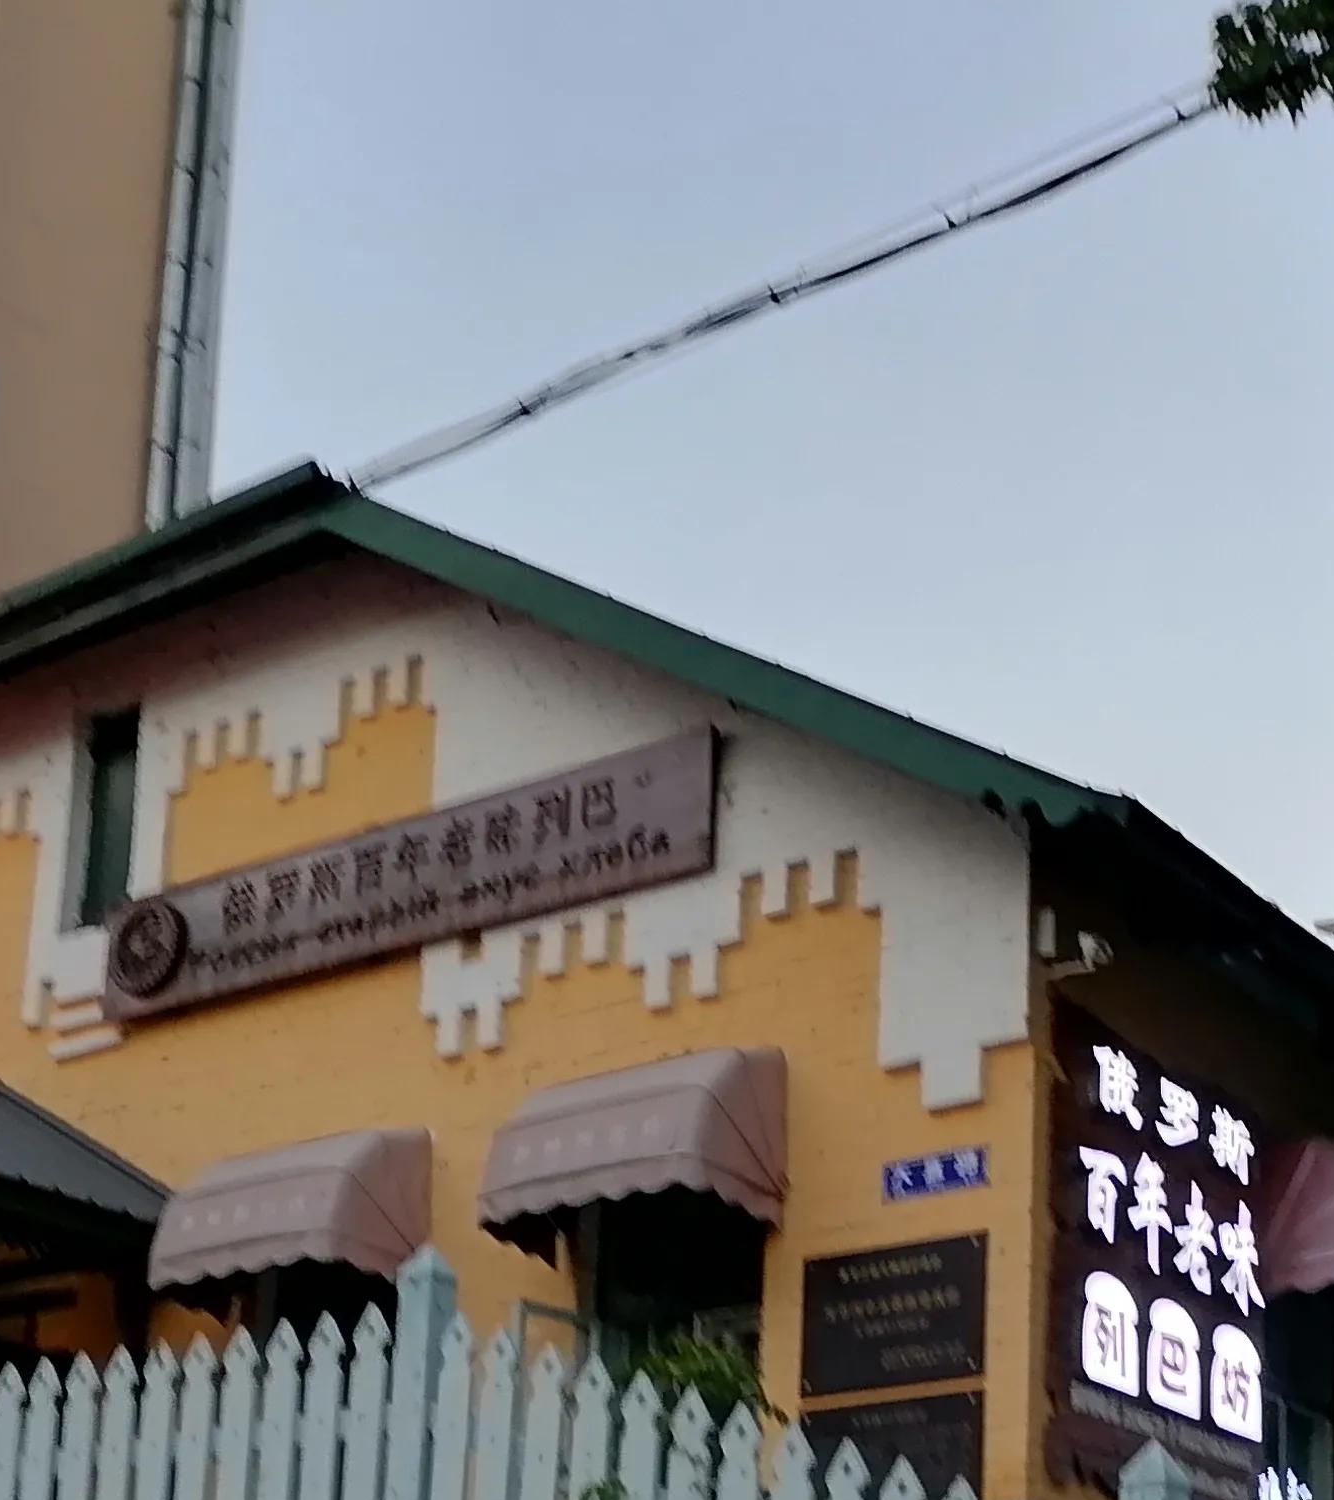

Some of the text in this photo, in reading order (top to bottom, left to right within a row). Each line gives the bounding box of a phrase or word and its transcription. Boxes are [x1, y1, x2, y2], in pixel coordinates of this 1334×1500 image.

[1092, 1044, 1255, 1187] 俄罗斯
[1078, 1145, 1266, 1317] 百年老味
[1094, 1301, 1252, 1423] 列巴坊
